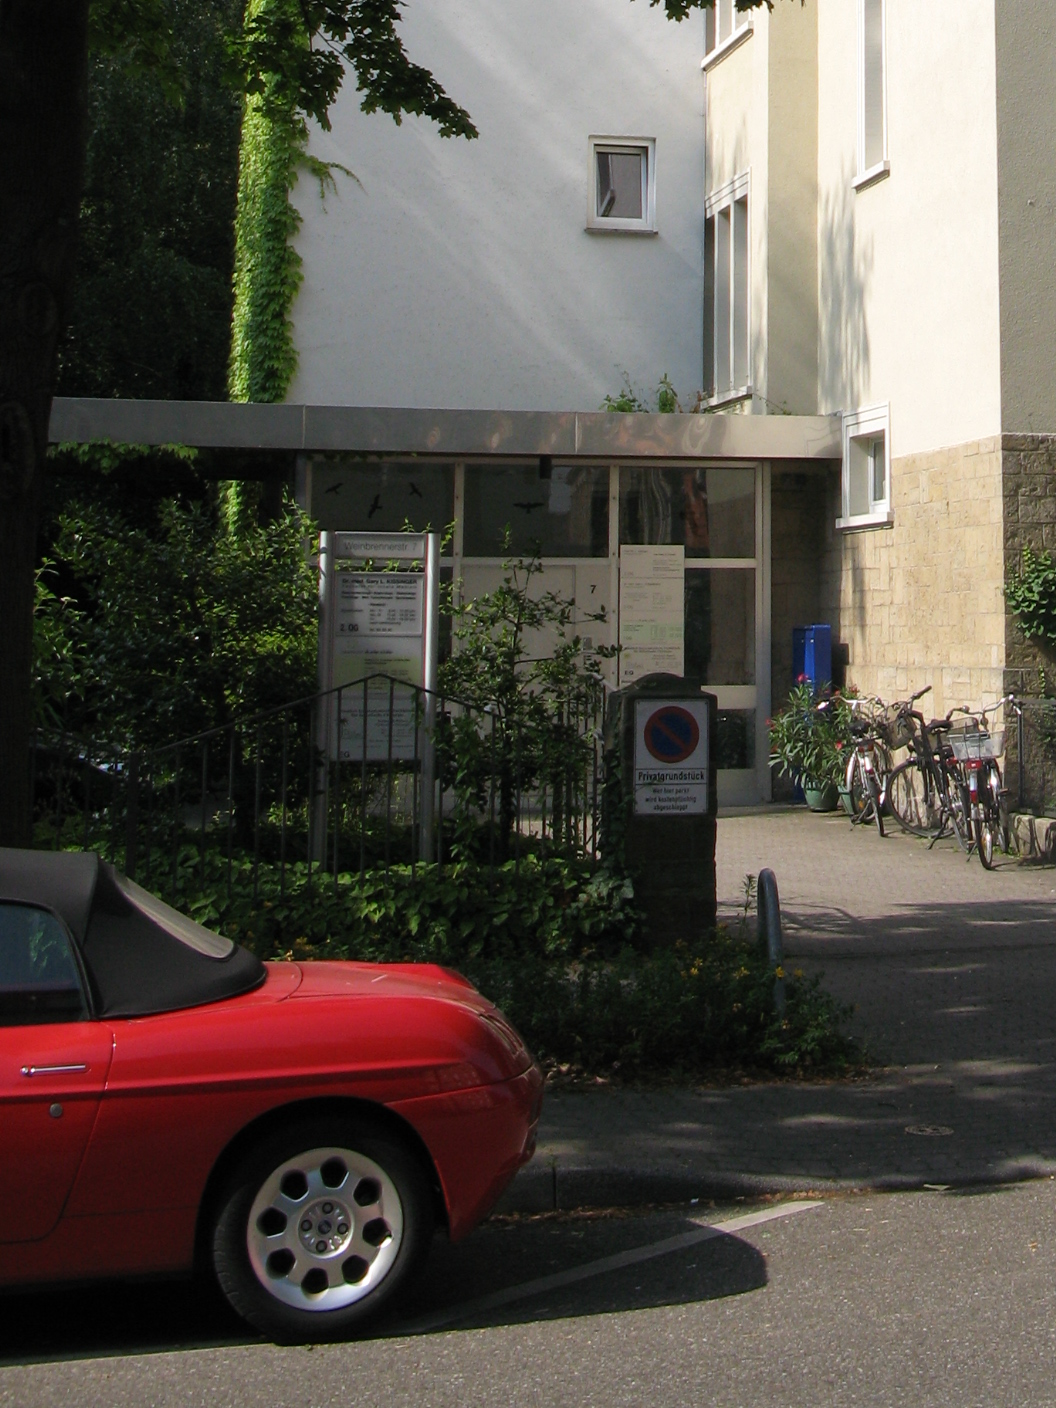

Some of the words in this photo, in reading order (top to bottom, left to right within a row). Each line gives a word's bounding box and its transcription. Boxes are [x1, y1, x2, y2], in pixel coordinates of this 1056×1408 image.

[412, 542, 418, 551] 7
[590, 584, 597, 594] 7
[638, 771, 705, 782] Privatgrundstück
